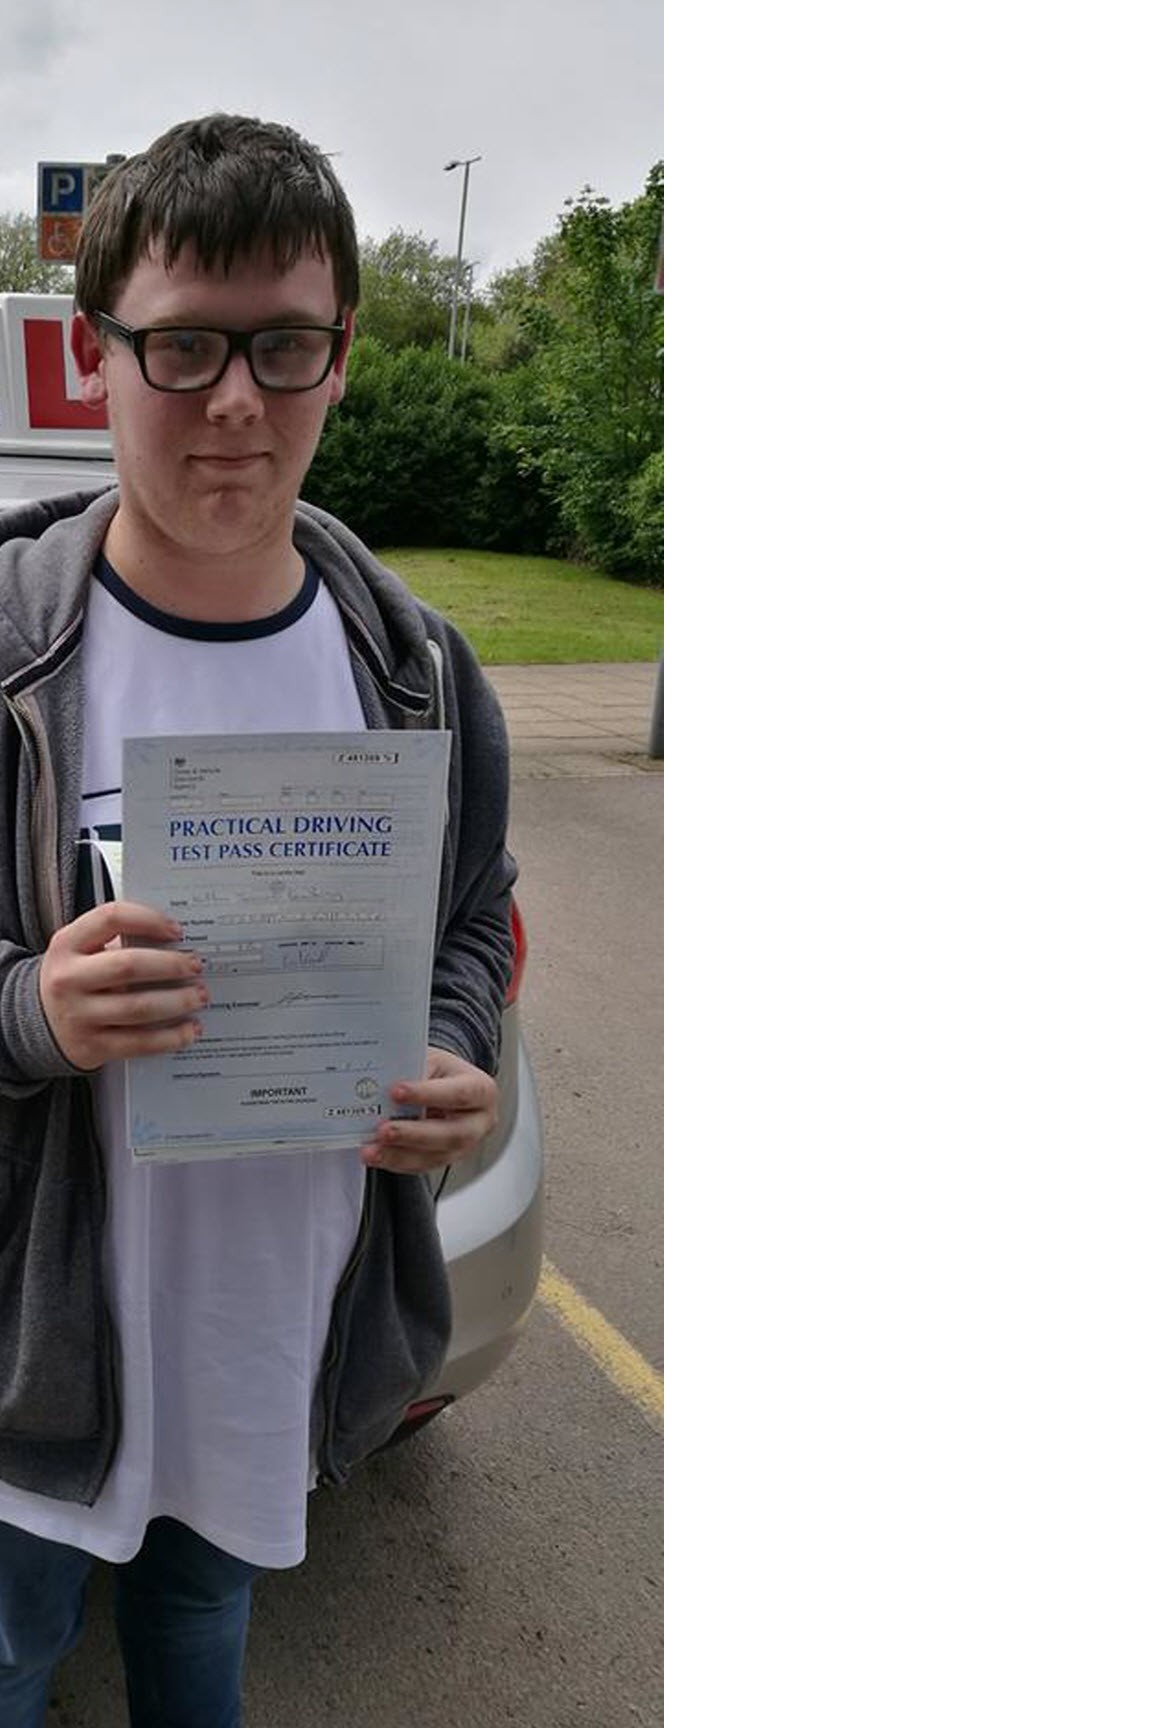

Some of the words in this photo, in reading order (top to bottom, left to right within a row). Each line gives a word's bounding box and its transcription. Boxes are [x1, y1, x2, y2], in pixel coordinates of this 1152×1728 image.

[51, 172, 75, 206] P
[169, 817, 285, 838] PRACTICAL
[294, 815, 392, 834] DRIVING
[169, 845, 211, 862] TEST
[219, 842, 263, 860] PASS
[269, 841, 391, 857] CERTIFICATE
[250, 1086, 308, 1099] IMPORTANT
